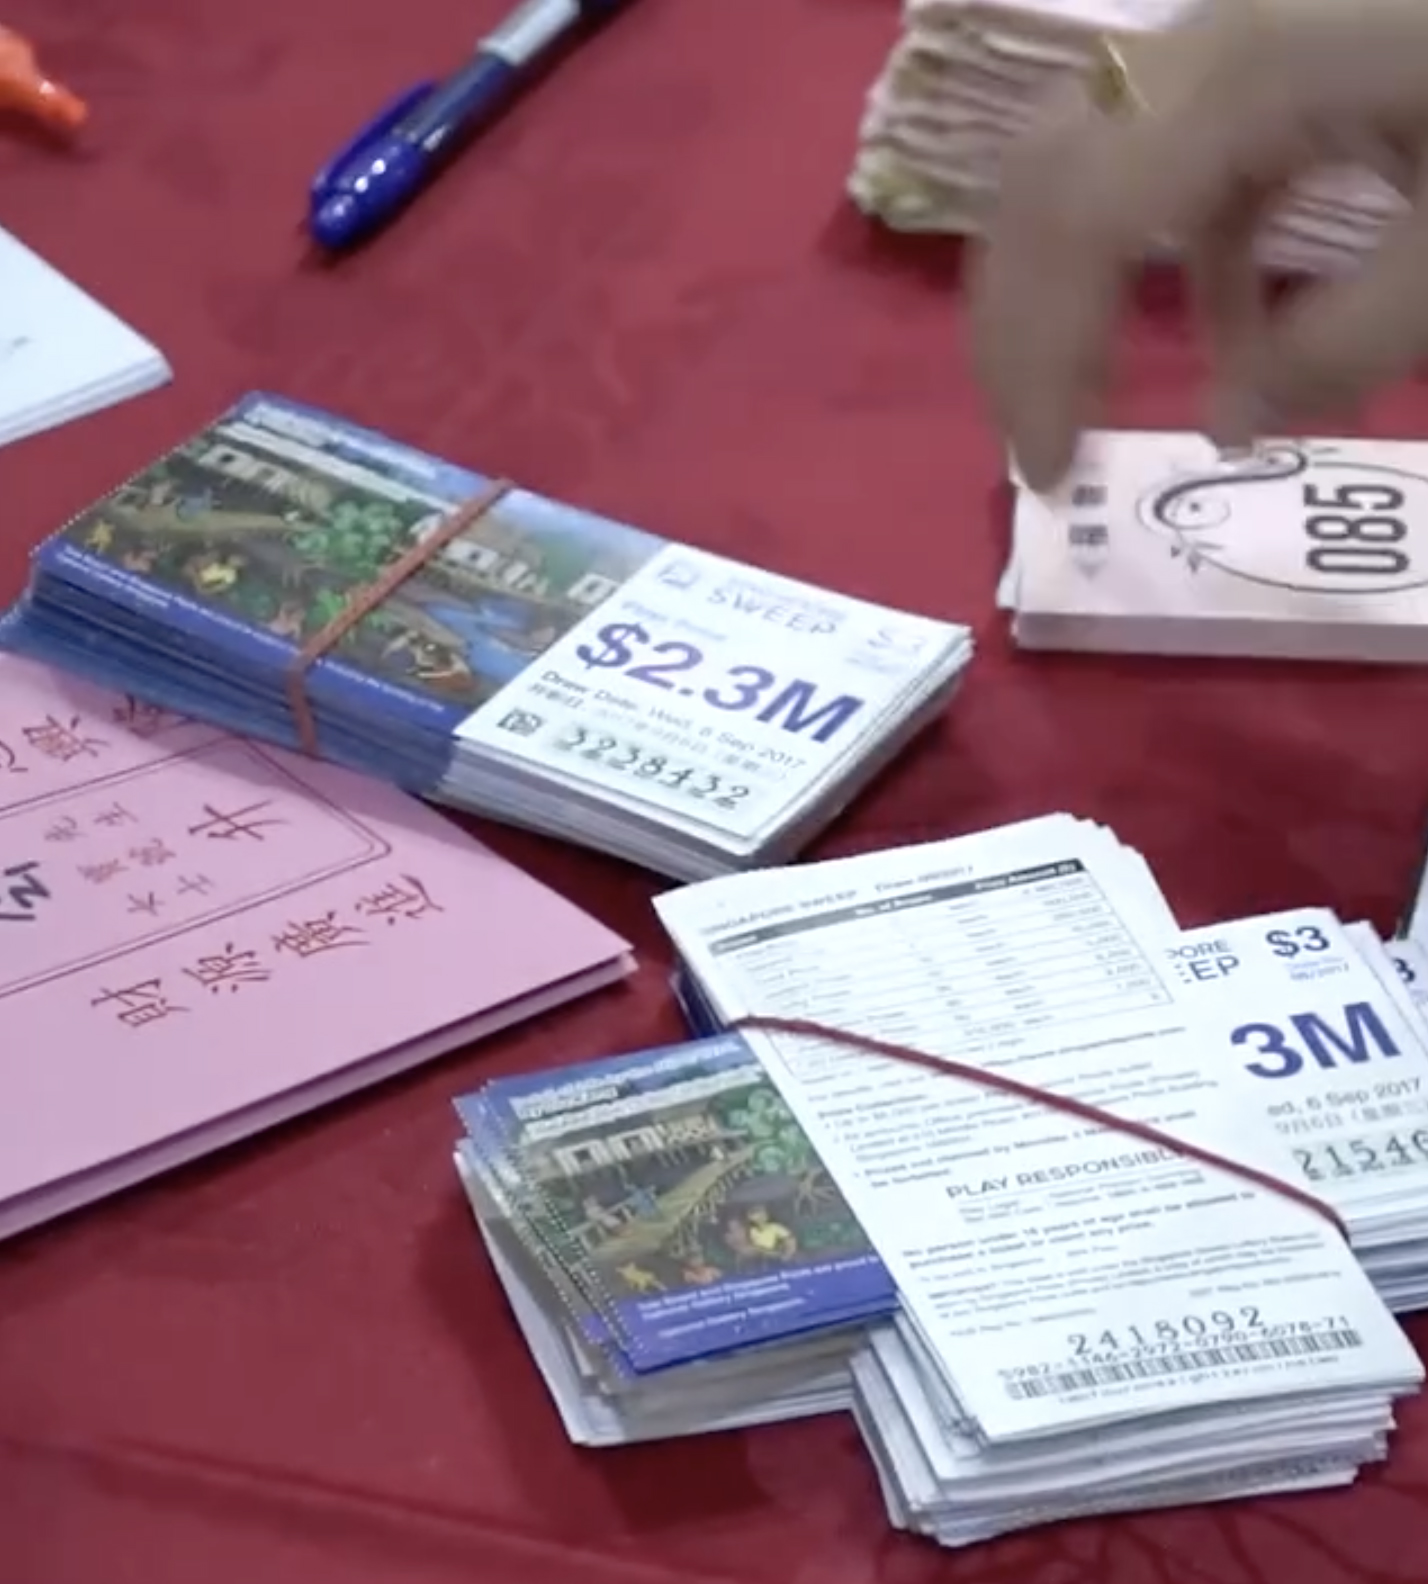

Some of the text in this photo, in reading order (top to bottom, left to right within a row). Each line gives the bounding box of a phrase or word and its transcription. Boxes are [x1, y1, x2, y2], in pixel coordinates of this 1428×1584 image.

[1303, 483, 1411, 577] 085
[576, 620, 865, 744] $2.3M
[757, 744, 807, 773] 2017
[90, 873, 445, 1028] 財源廣進
[1265, 925, 1331, 960] $3
[1229, 1001, 1401, 1080] 3M
[1324, 1085, 1370, 1109] Sep
[1371, 1075, 1423, 1100] 2017
[945, 1145, 1188, 1201] PLAY RESPONSIBL
[1066, 1305, 1267, 1356] 2418092
